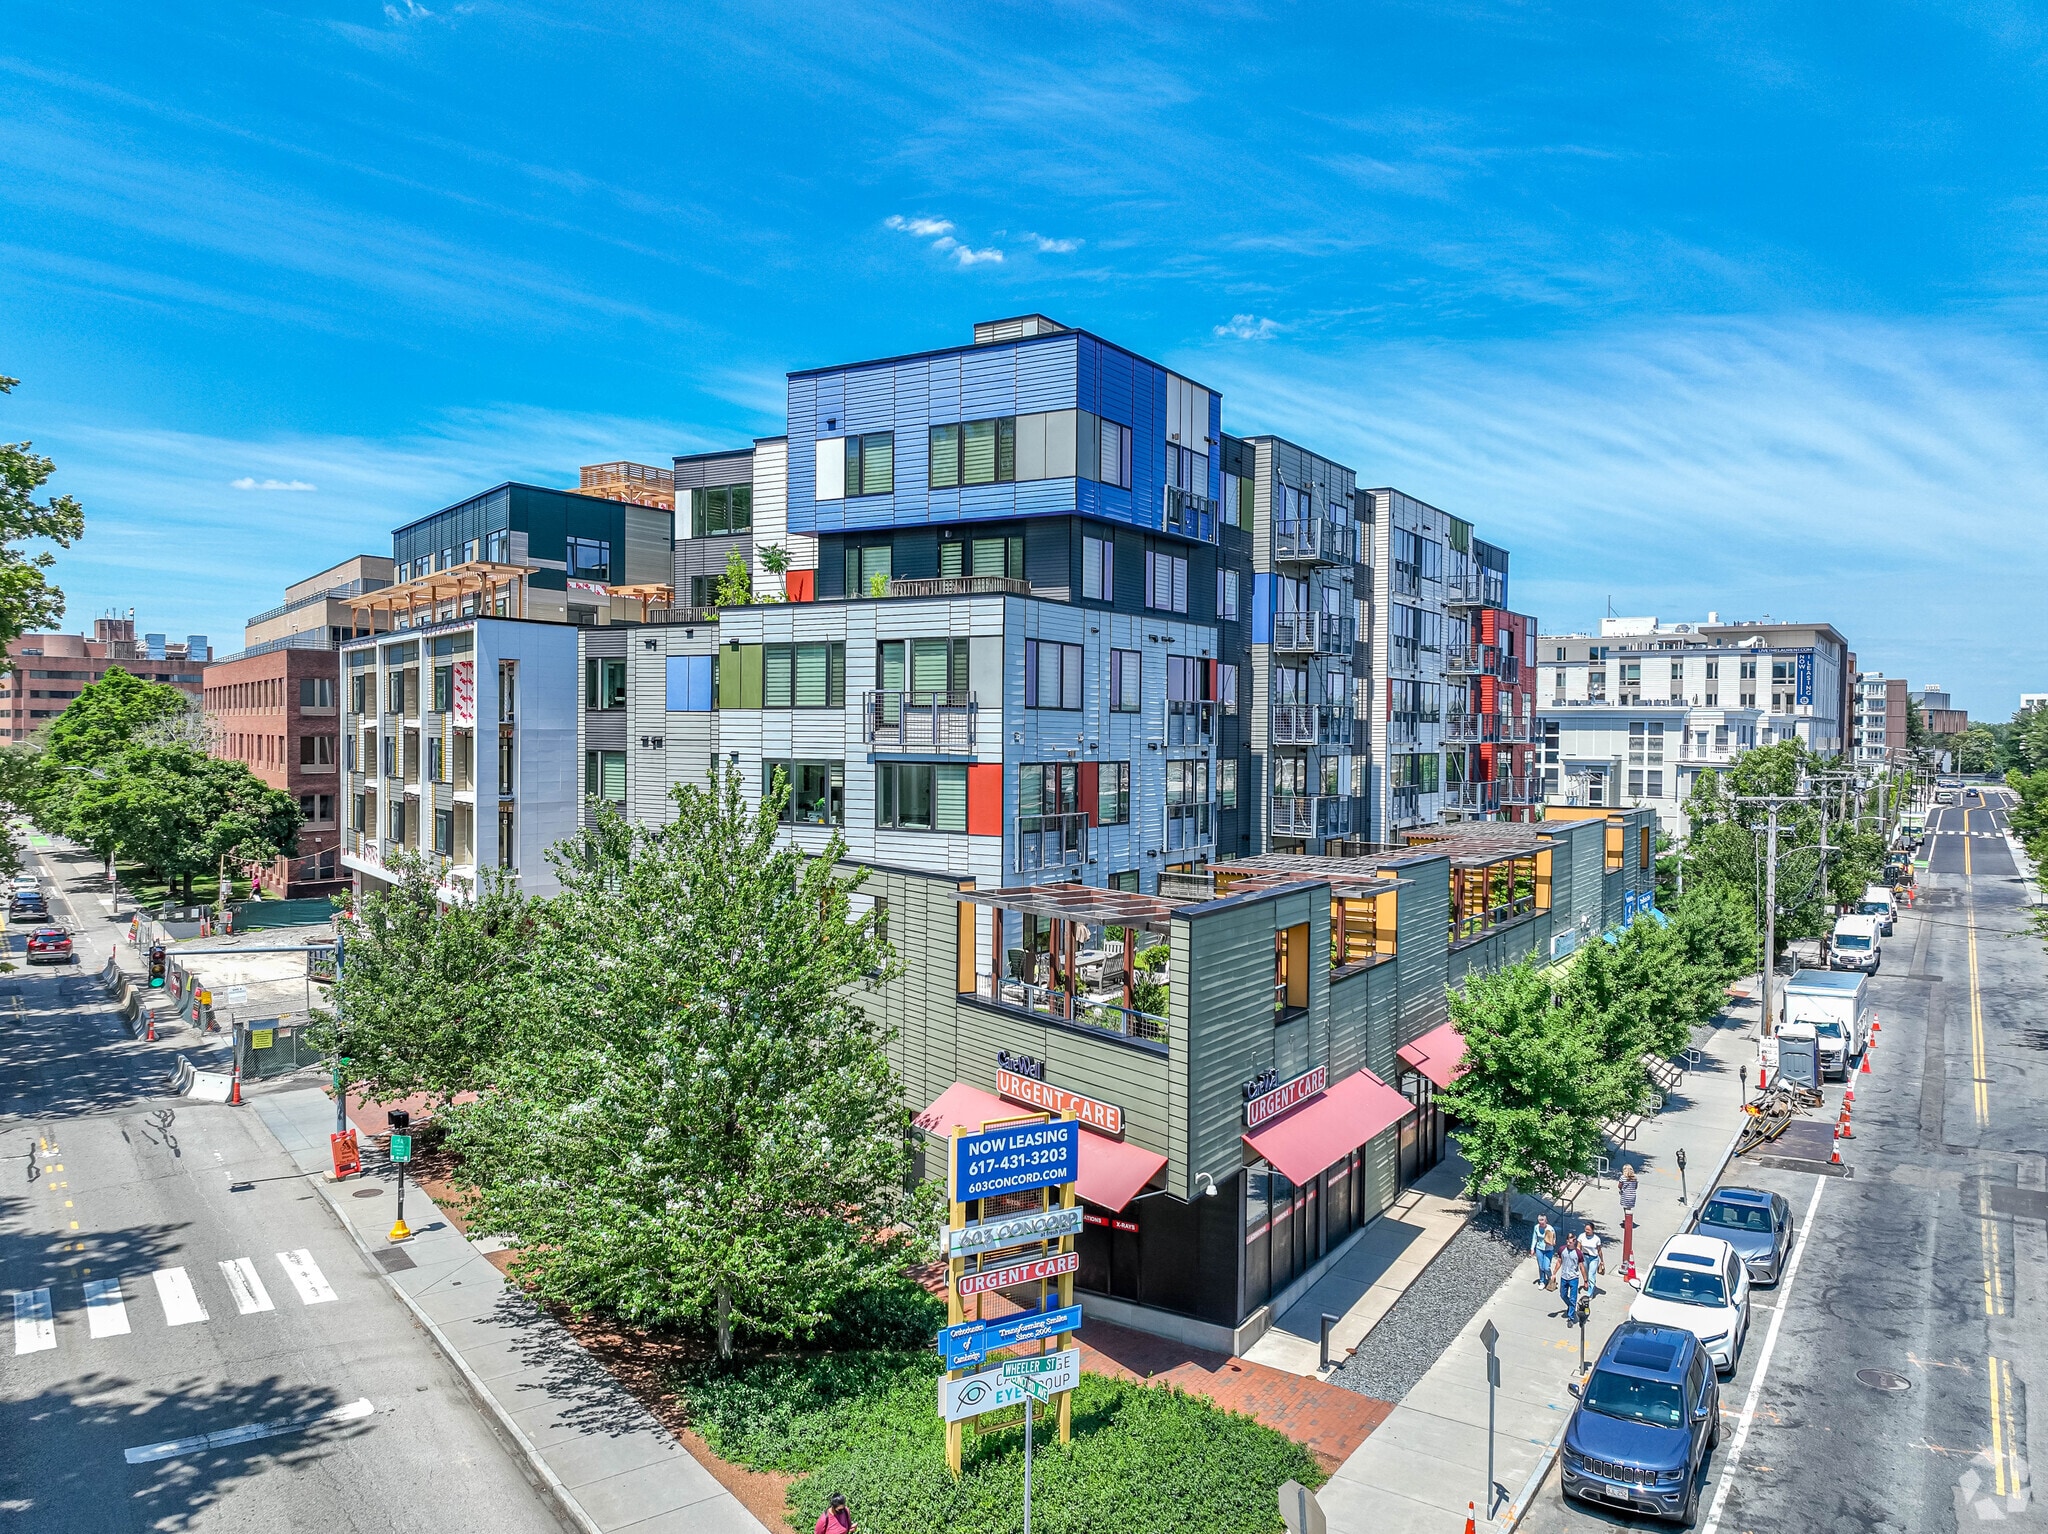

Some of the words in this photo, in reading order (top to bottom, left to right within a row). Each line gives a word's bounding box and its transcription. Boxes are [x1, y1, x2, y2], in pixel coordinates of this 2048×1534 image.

[1000, 1072, 1064, 1110] URGENT
[1070, 1096, 1116, 1130] CARE
[1251, 1083, 1296, 1123] URGENT
[1298, 1069, 1323, 1098] CARE
[969, 1137, 1006, 1156] NOW
[1009, 1128, 1068, 1150] LEASING
[968, 1147, 1067, 1176] 617-431-3203
[968, 1167, 1067, 1194] 603CONCORD.COM
[1083, 1215, 1102, 1223] ATIONS
[1116, 1221, 1135, 1230] X-RAYS
[959, 1229, 994, 1248] 603
[996, 1211, 1078, 1239] CONCORD
[1059, 1226, 1072, 1235] pond
[962, 1265, 1031, 1294] URGENT
[1035, 1254, 1076, 1277] CARE
[1015, 1333, 1034, 1342] Since
[1035, 1326, 1052, 1337] 2006
[962, 1336, 972, 1351] of
[1005, 1360, 1040, 1376] WHEELER
[1046, 1358, 1056, 1370] ST
[996, 1387, 1022, 1404] EYE
[1037, 1385, 1048, 1400] AVE
